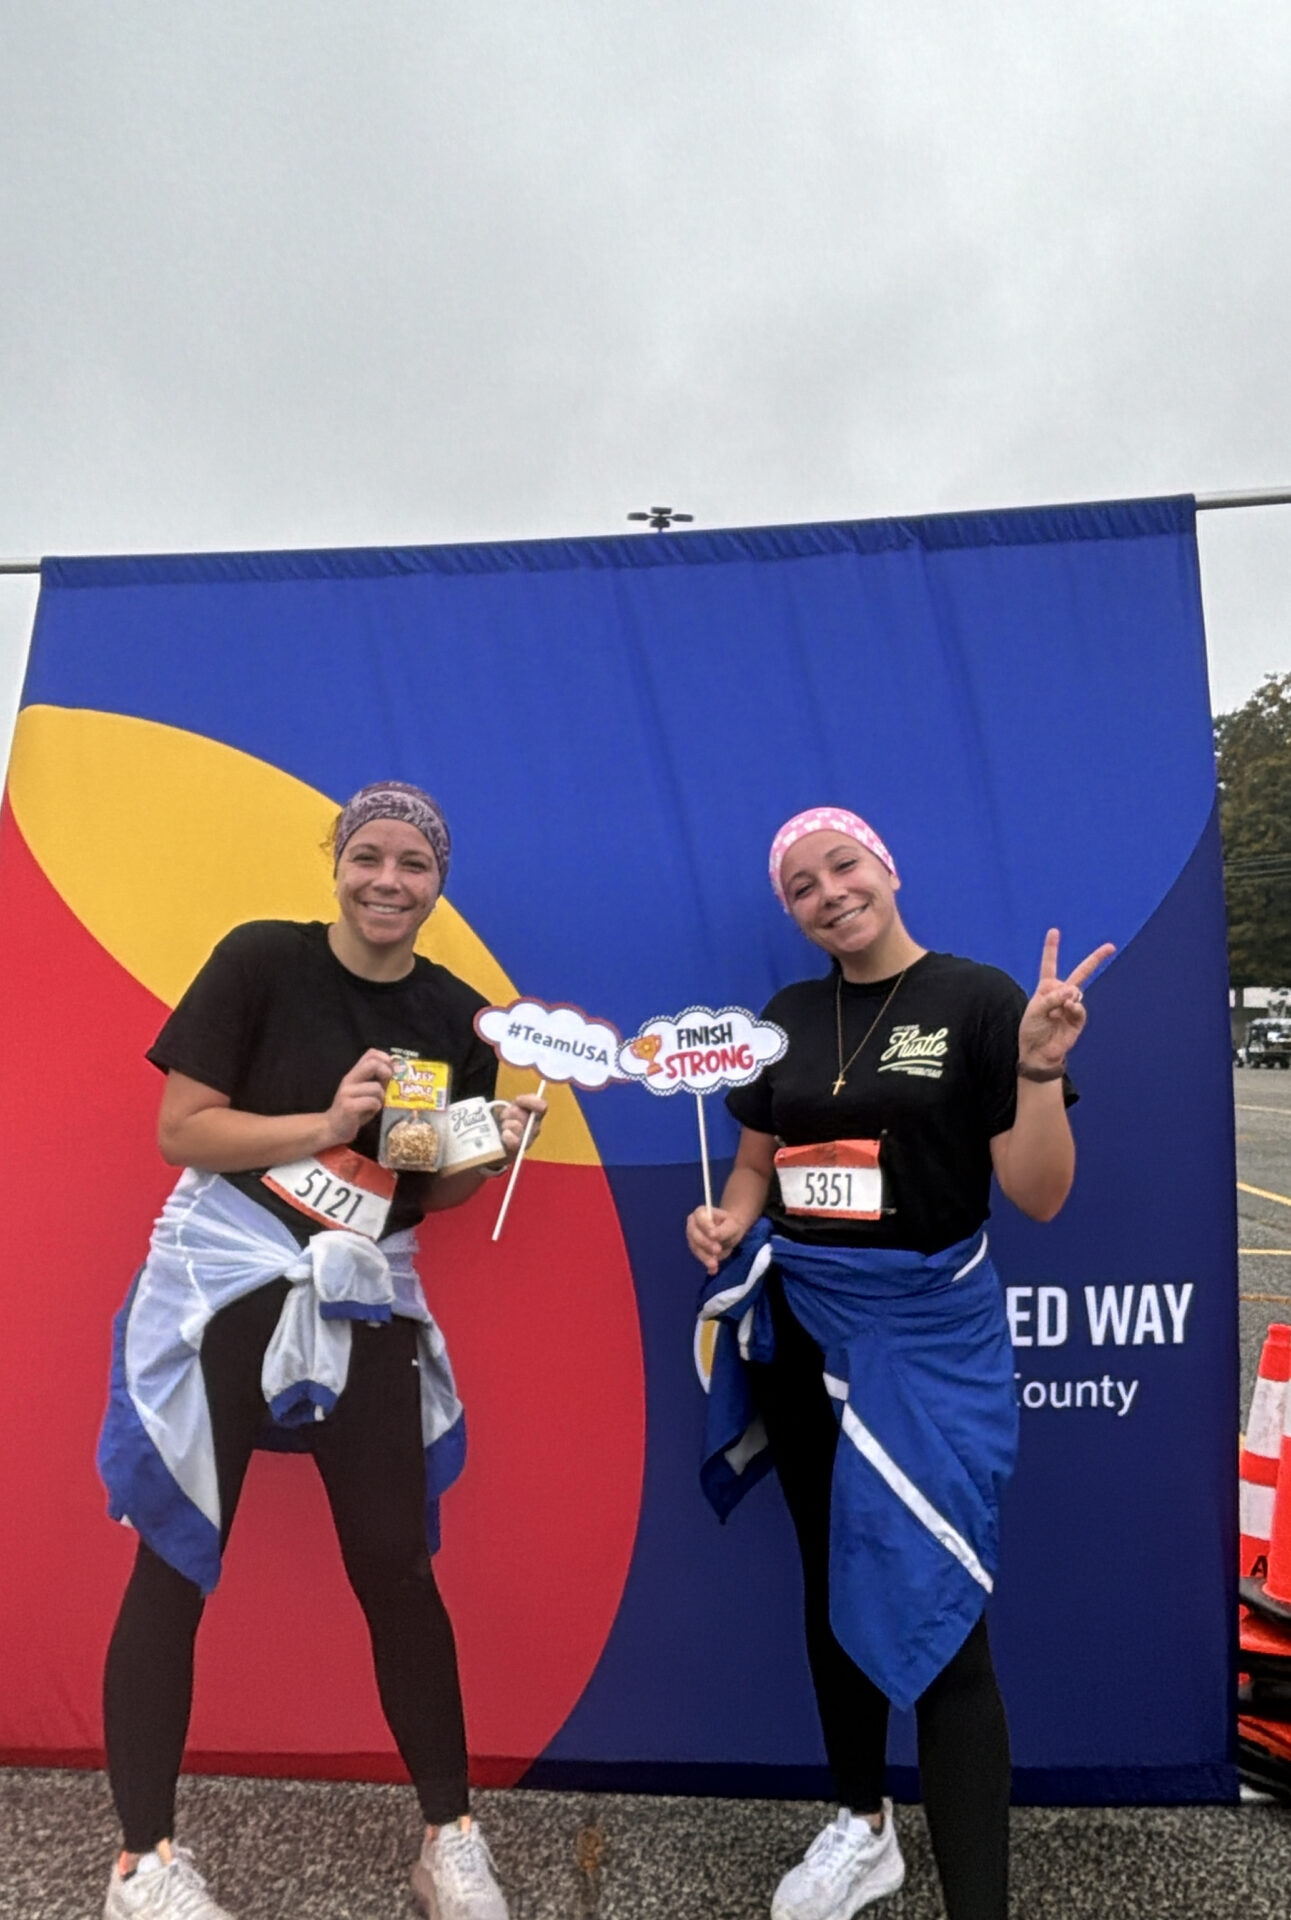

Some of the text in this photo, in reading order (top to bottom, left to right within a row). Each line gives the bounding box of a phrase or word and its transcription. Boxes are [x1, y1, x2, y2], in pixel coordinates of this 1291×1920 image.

[508, 1021, 609, 1066] #TeamUSA
[676, 1022, 733, 1050] FINISH
[880, 1027, 948, 1062] Hustle
[665, 1046, 754, 1079] STRONG
[294, 1168, 365, 1225] 5121
[804, 1172, 853, 1207] 5351
[1084, 1283, 1194, 1346] WAY
[1013, 1373, 1139, 1416] ounty
